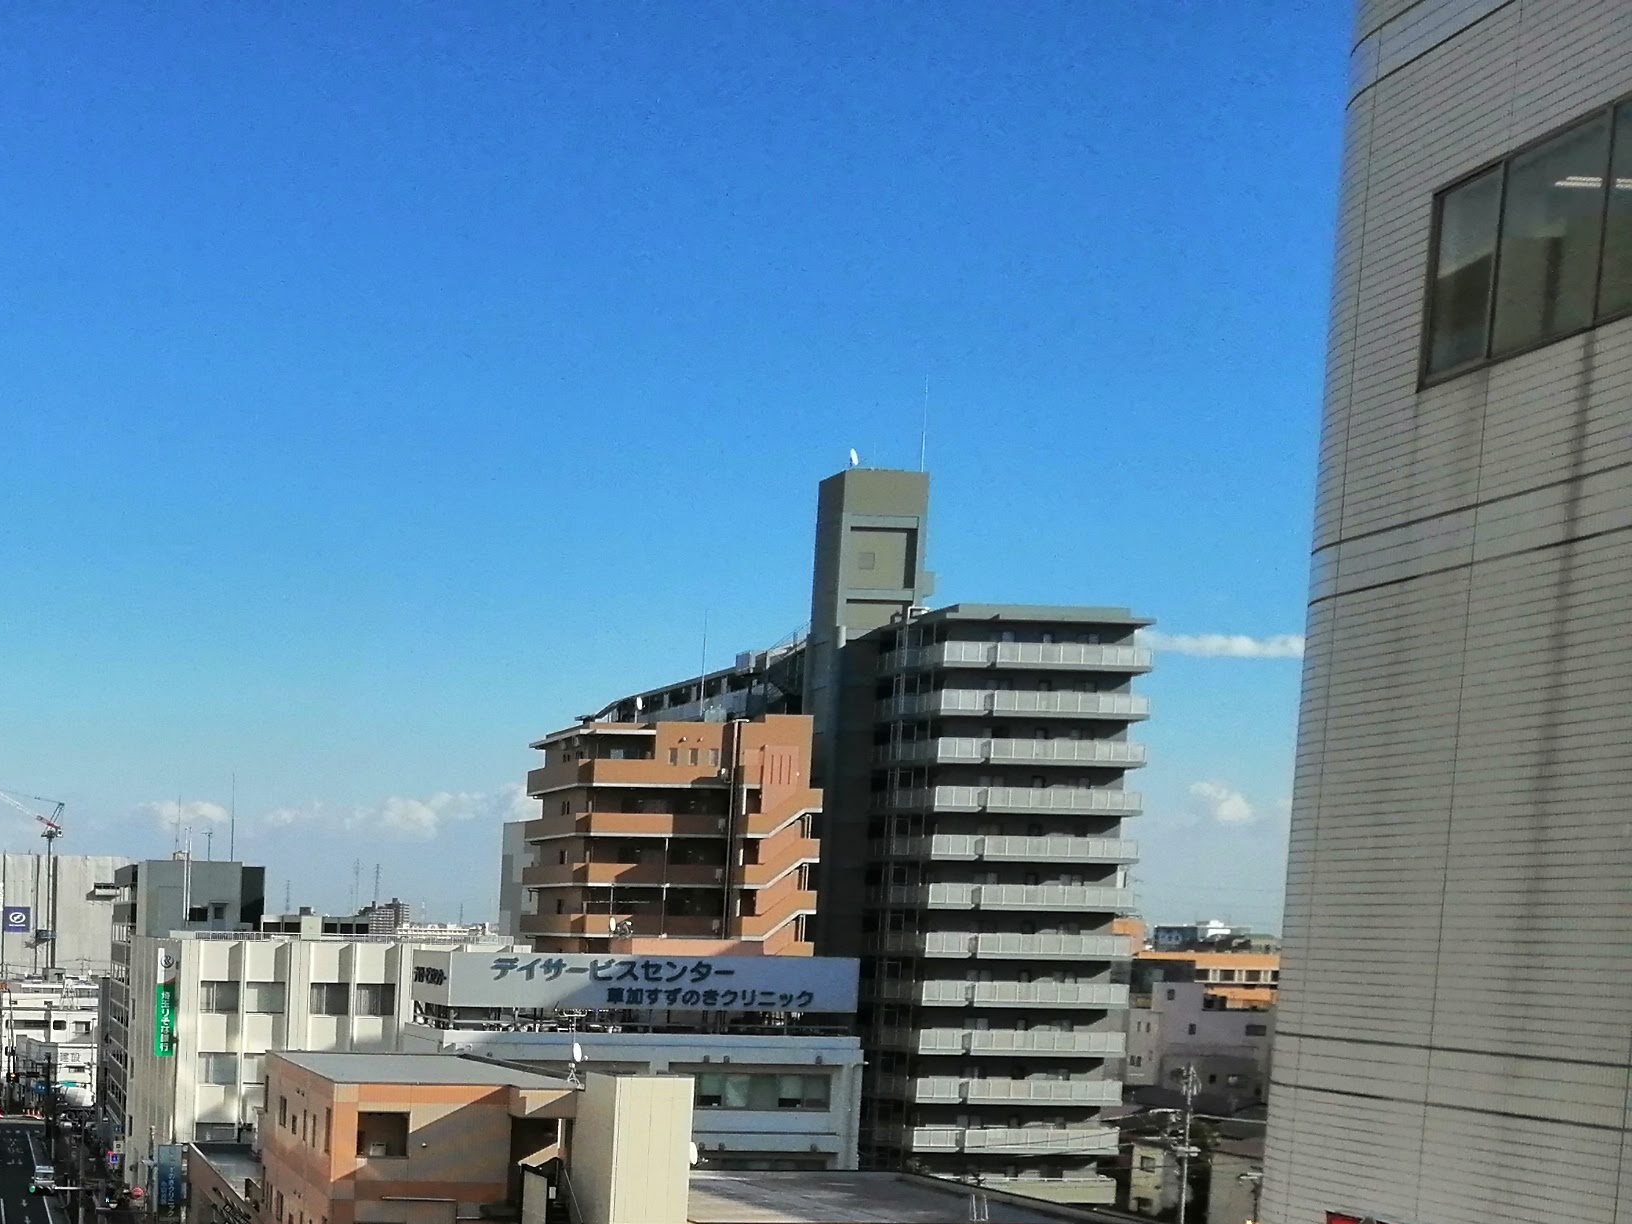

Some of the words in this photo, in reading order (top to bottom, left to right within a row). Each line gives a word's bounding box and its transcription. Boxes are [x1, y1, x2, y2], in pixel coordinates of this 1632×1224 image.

[490, 957, 735, 983] デイサービスセンター
[607, 987, 814, 1008] 草加すずのきクリニック
[159, 990, 171, 1052] 埼玉りそな銀行
